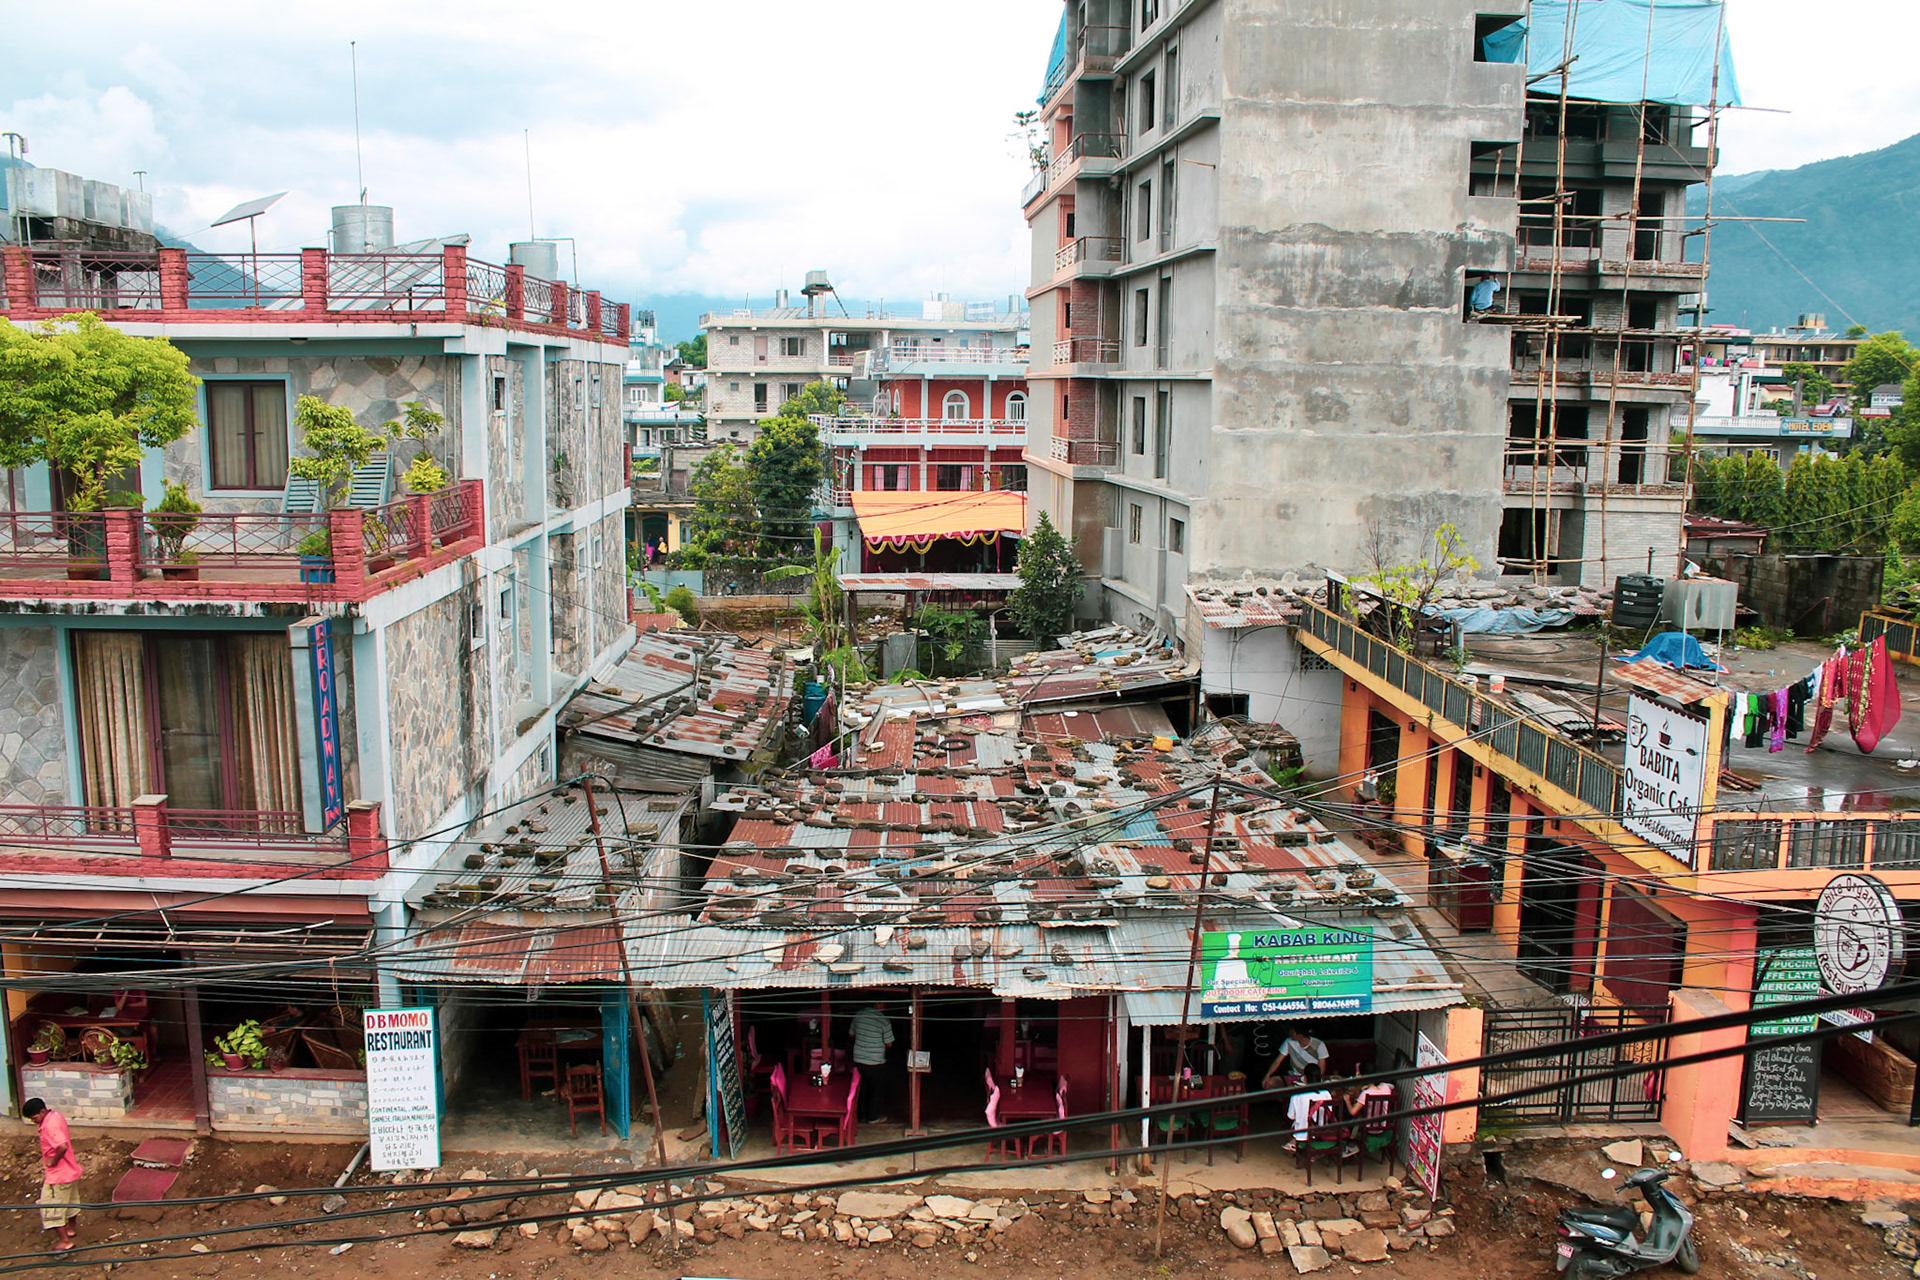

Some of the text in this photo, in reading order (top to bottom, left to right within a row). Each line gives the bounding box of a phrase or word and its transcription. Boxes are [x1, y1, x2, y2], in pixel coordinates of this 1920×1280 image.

[1789, 422, 1832, 431] HOTEL EDEN
[316, 624, 336, 805] BROADWAY
[1640, 745, 1680, 784] BABITA
[1625, 767, 1694, 822] Organic Cafe
[1626, 798, 1692, 851] & Restaurant
[1846, 877, 1880, 918] Organic
[1254, 932, 1368, 946] KABAB KING
[1274, 952, 1358, 964] RESTAURANT
[1818, 952, 1868, 994] Restaurant
[1206, 978, 1219, 986] Our
[1758, 983, 1819, 991] MERICANO
[1224, 988, 1244, 996] DOOR
[1246, 987, 1287, 995] CATERING
[1213, 1004, 1240, 1014] Contact
[1244, 1004, 1258, 1012] No:
[388, 1012, 428, 1028] MOMO
[367, 1030, 432, 1052] RESTAURANT
[1794, 1055, 1813, 1063] Coffee
[1754, 1060, 1770, 1072] Black
[1755, 1071, 1806, 1082] Organic Salads
